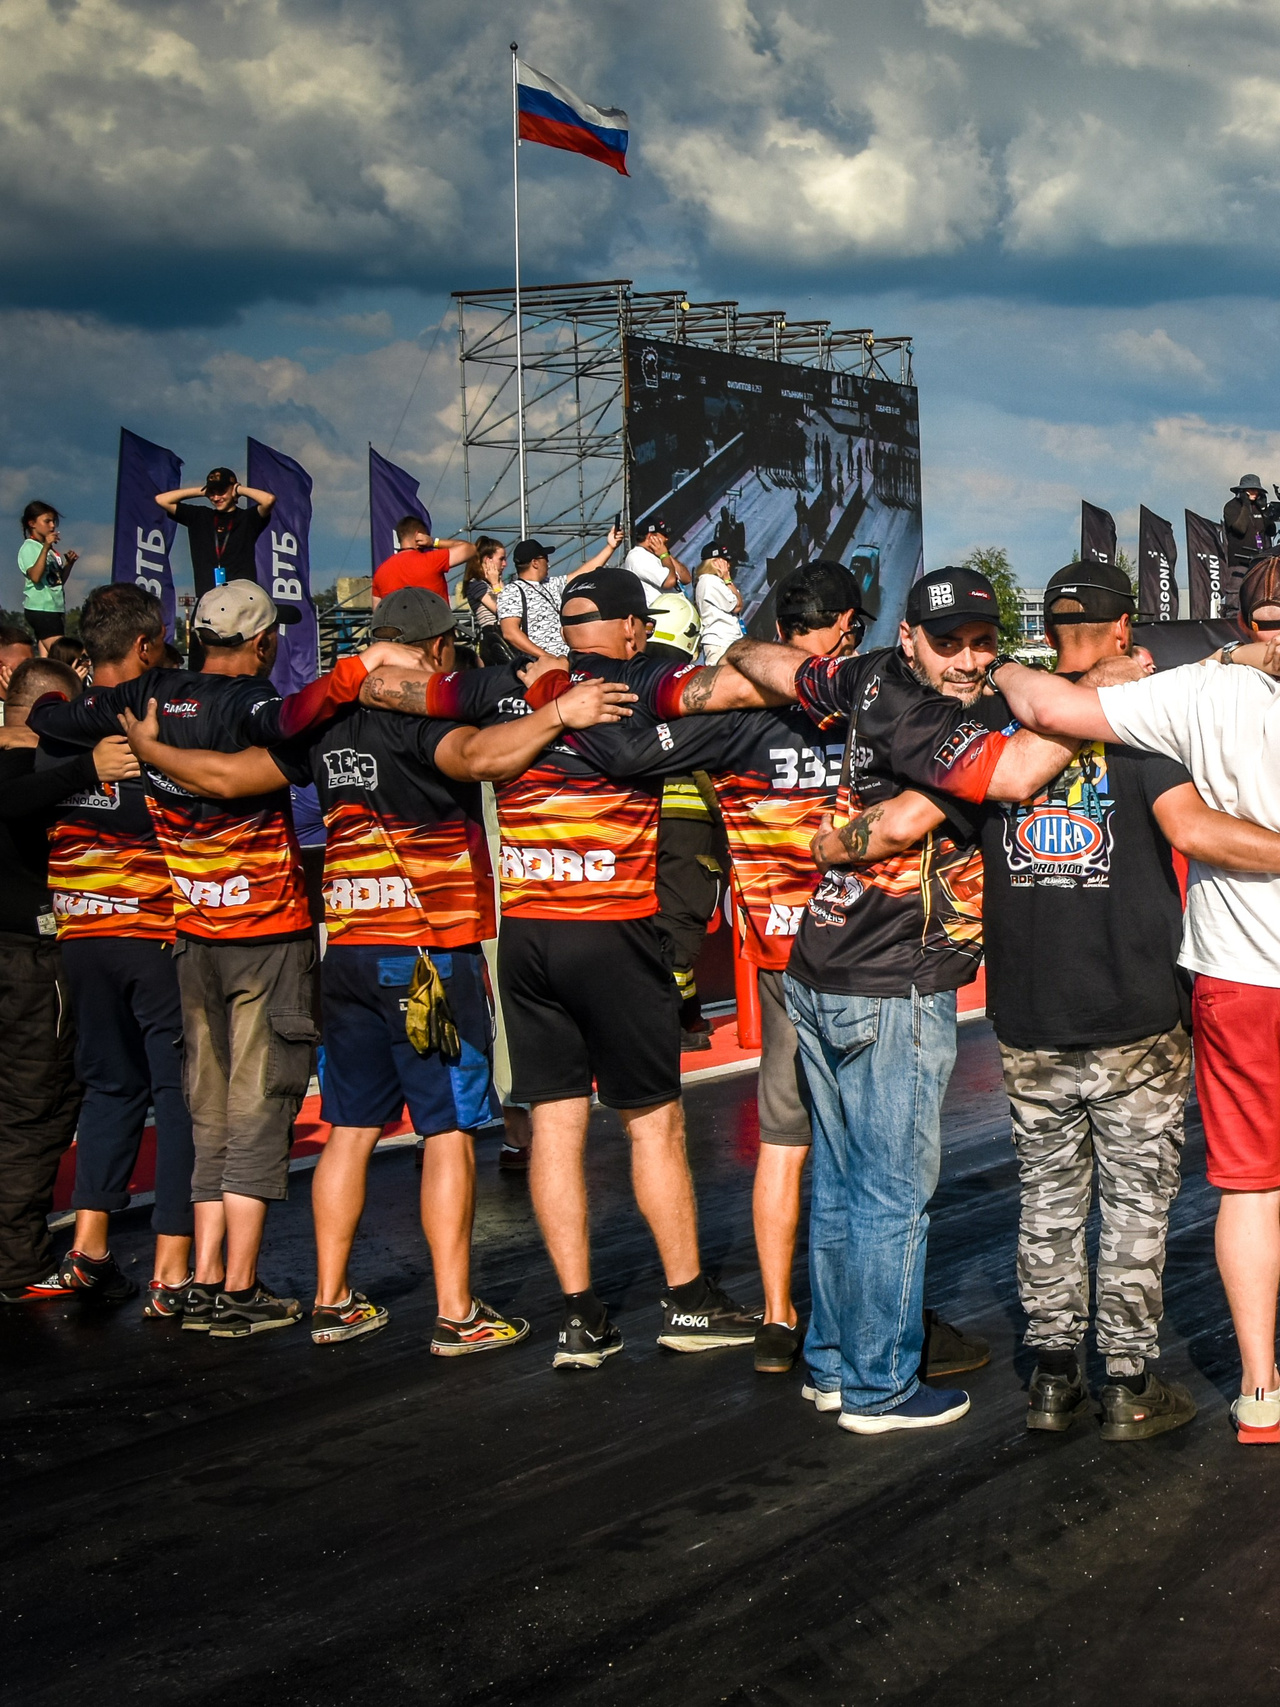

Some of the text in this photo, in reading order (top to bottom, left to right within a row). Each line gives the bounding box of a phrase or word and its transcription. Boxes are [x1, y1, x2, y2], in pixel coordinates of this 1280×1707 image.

[135, 526, 166, 598] ВТБ
[271, 530, 302, 601] ВТБ
[1159, 552, 1170, 620] OSGONKI
[63, 796, 117, 808] HNOLOGY
[1032, 817, 1087, 853] NHRA
[501, 846, 616, 881] RDRC
[1033, 863, 1082, 874] PRO MOD
[330, 876, 423, 910] RDRC
[765, 903, 805, 936] RD
[671, 1313, 709, 1328] HOKA
